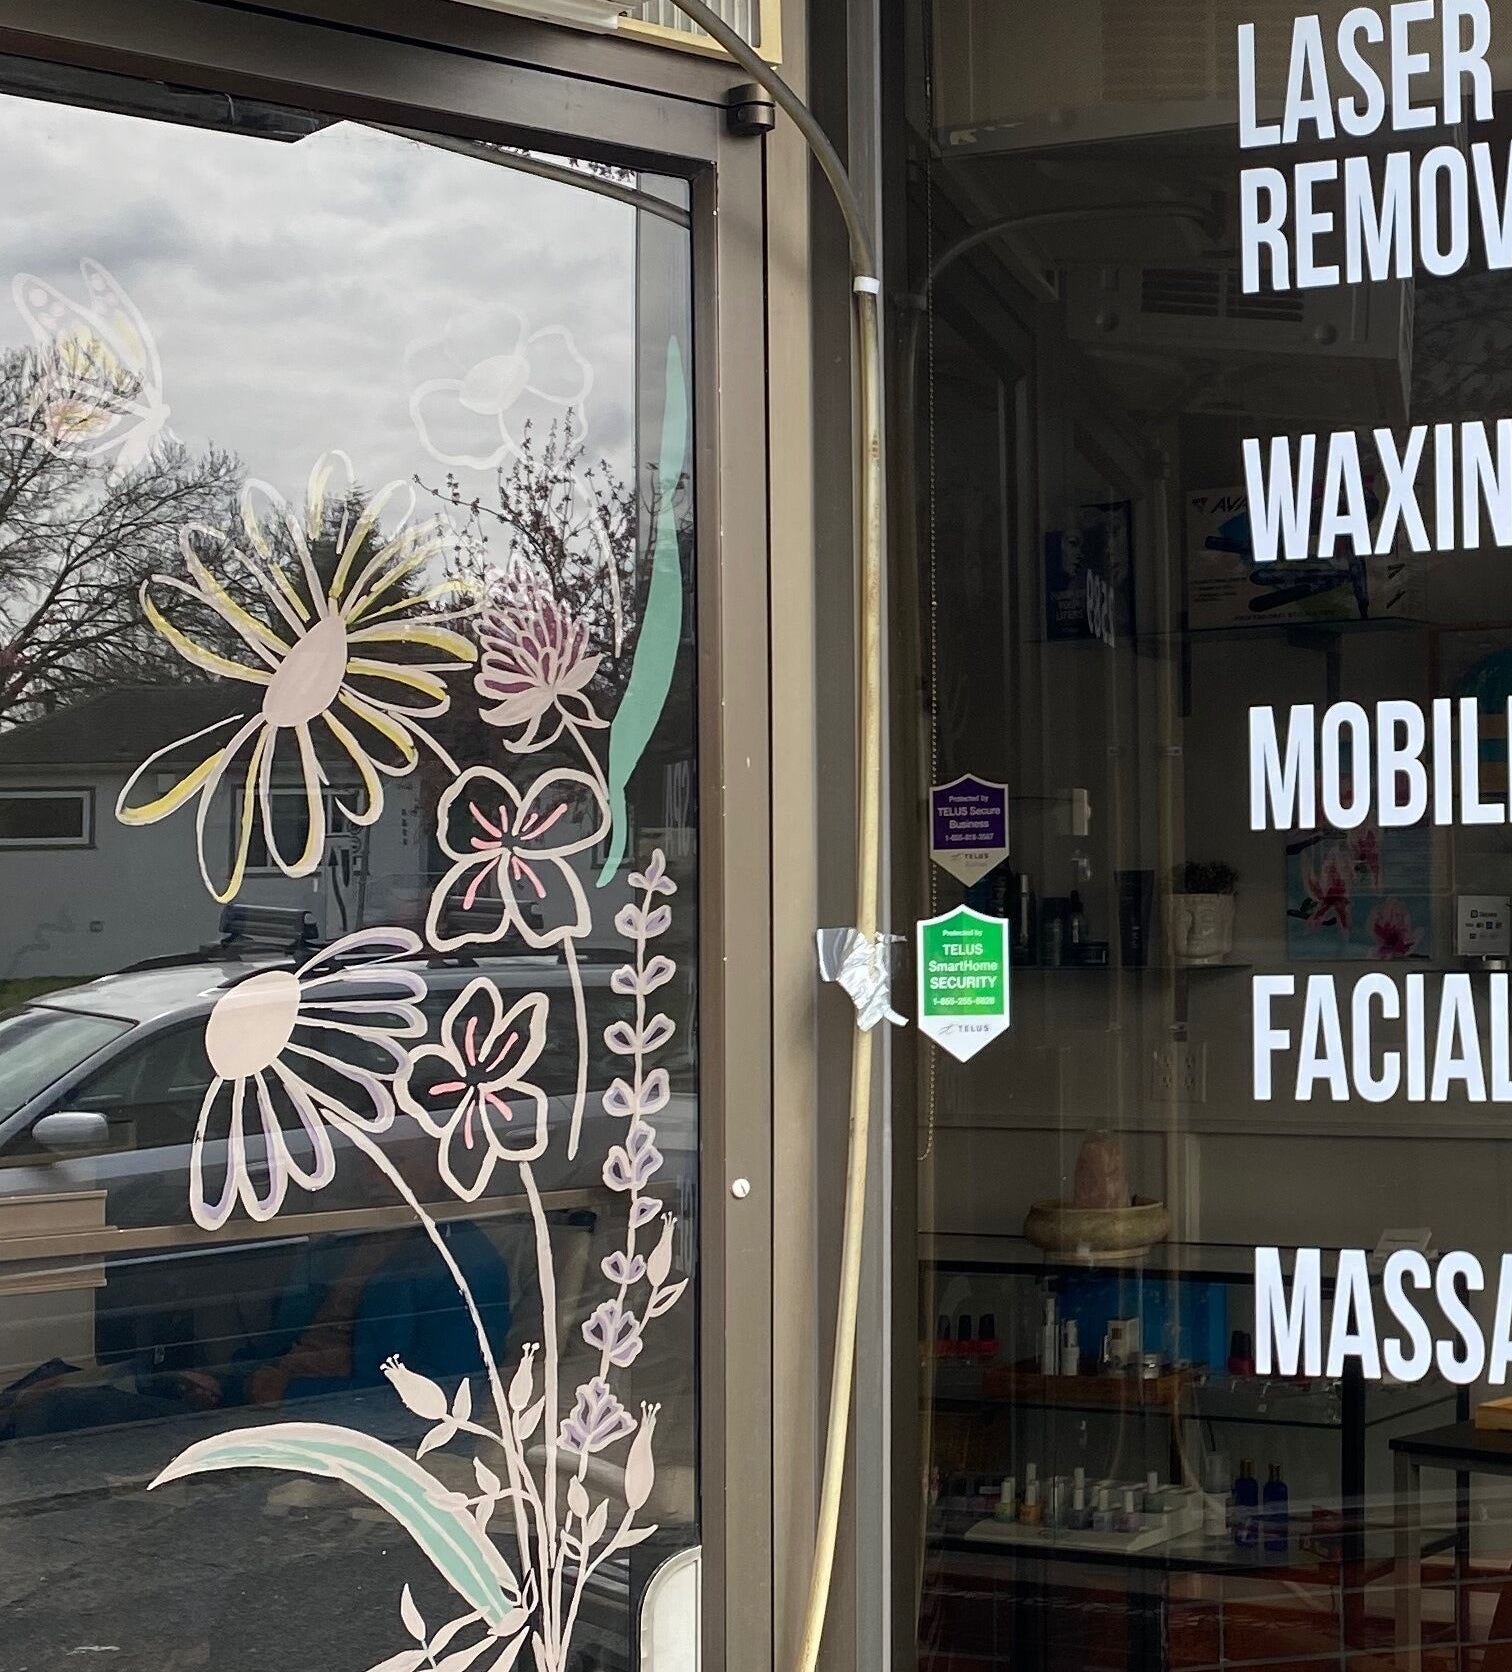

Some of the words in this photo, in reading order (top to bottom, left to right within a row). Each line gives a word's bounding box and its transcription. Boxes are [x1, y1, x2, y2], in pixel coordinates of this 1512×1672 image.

[1237, 0, 1494, 149] LASER
[937, 806, 968, 817] TELUS
[970, 806, 1001, 816] Secure
[949, 819, 990, 829] Business
[964, 852, 989, 860] TELUS
[942, 929, 973, 937] Protected
[974, 929, 984, 938] by
[942, 943, 984, 956] TELUS
[928, 959, 999, 973] SmartHome
[929, 975, 998, 990] SECURITY
[957, 1024, 990, 1034] TELUS
